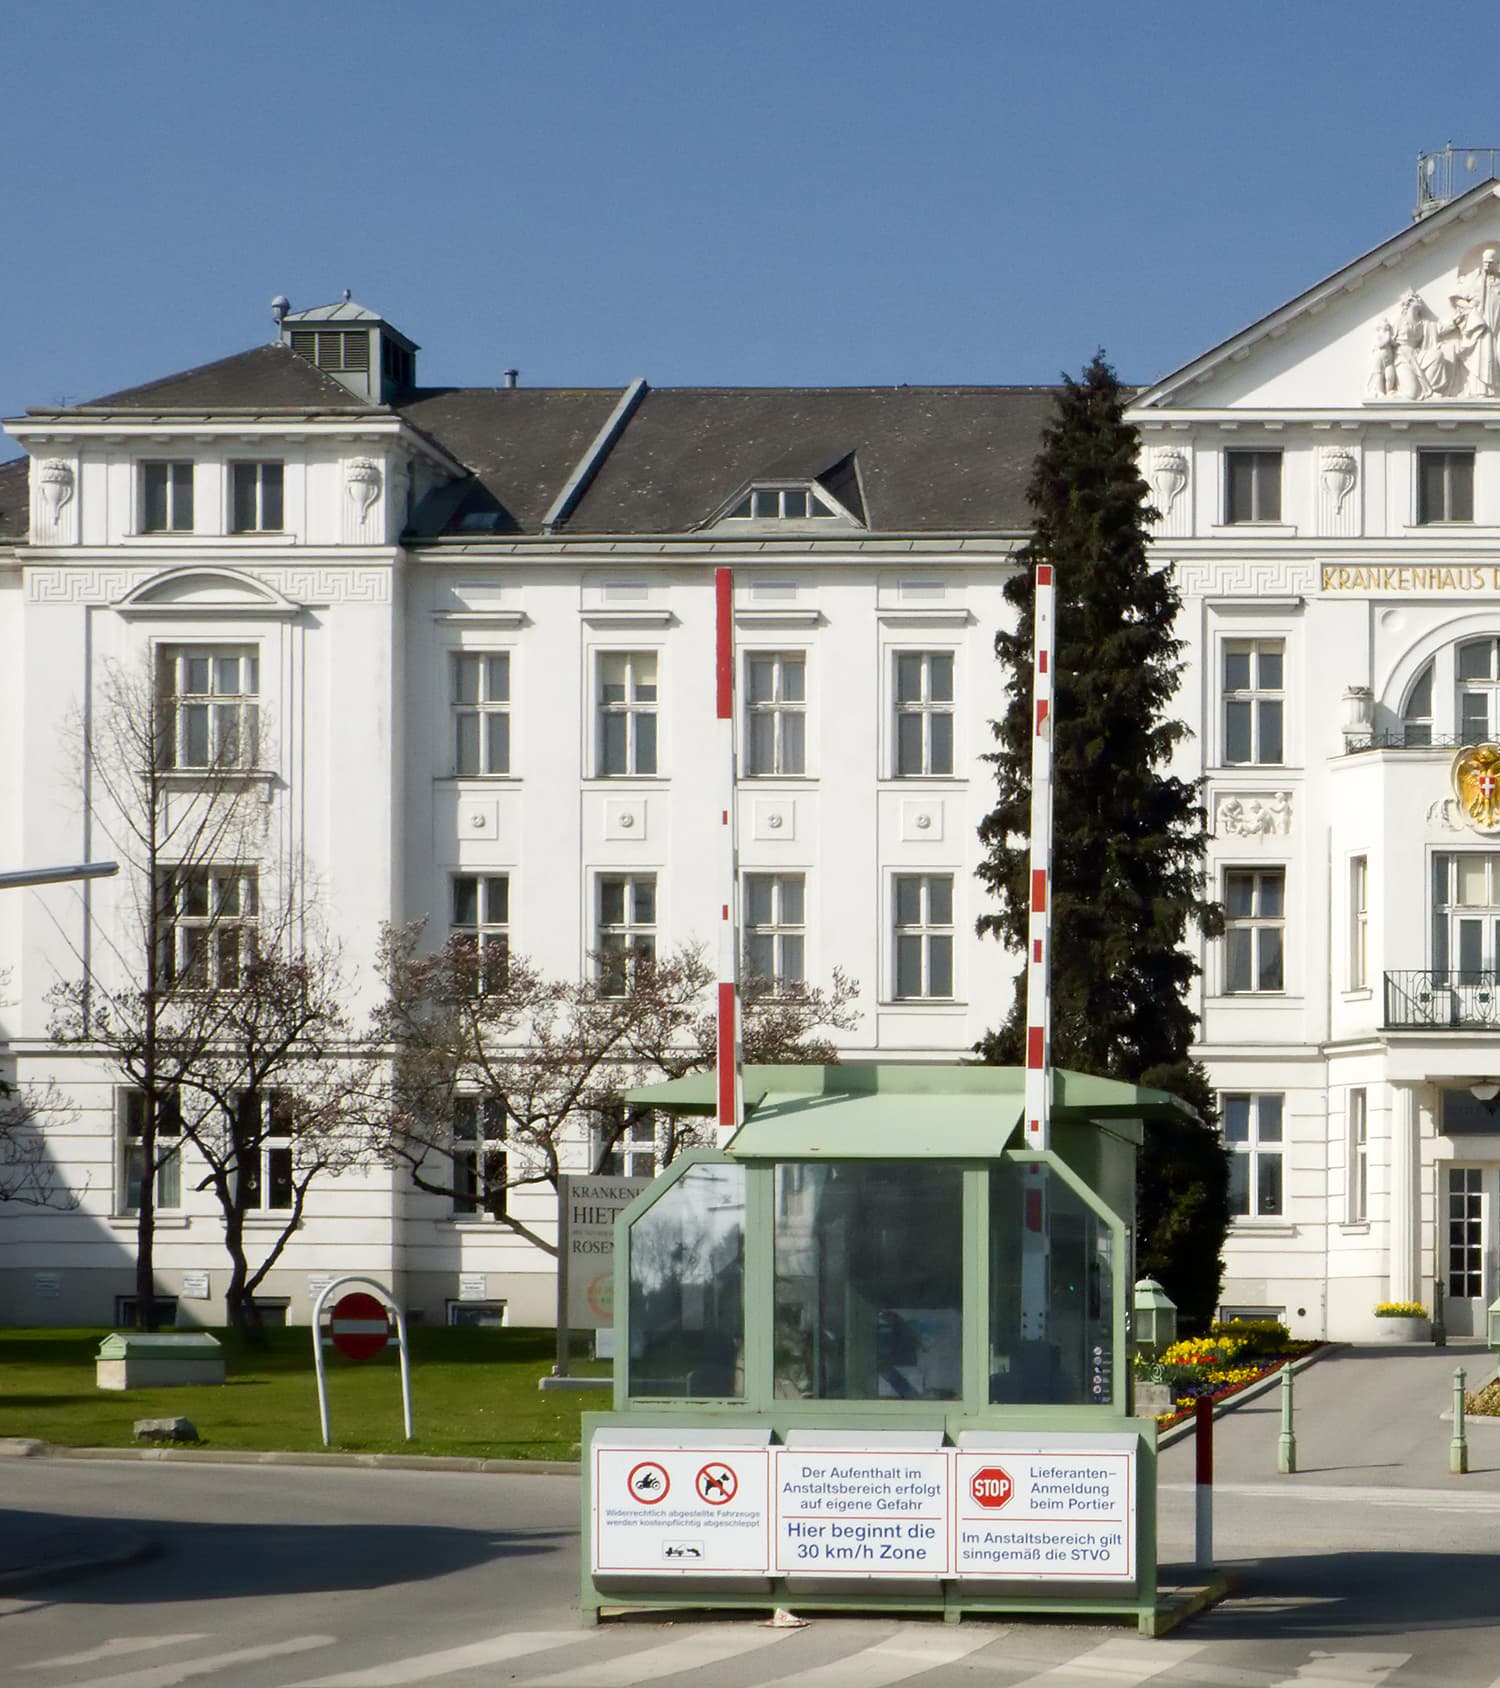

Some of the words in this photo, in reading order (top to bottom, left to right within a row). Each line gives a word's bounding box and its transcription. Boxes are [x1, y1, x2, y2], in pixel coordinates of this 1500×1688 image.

[1322, 566, 1485, 591] KRANKENHAUS
[572, 1186, 644, 1199] KRANKEN
[573, 1206, 624, 1225] HIET
[802, 1466, 826, 1478] Der
[830, 1467, 900, 1479] Aufenthalt
[905, 1468, 922, 1479] im
[783, 1482, 892, 1494] Anstaltsbereich
[895, 1483, 942, 1497] erfolgt
[974, 1479, 1010, 1497] STOP
[1030, 1483, 1110, 1496] Anmeldung
[800, 1498, 822, 1510] auf
[826, 1500, 872, 1512] eigene
[876, 1498, 923, 1510] Gefahr
[1030, 1498, 1064, 1510] beim
[1068, 1498, 1116, 1510] Portier
[606, 1509, 666, 1518] Widerrechtlich
[716, 1510, 760, 1519] Fahrzeuge
[640, 1519, 702, 1528] kostenpflichtig
[703, 1520, 760, 1528] abgeschleppt
[788, 1522, 826, 1538] Hier
[832, 1523, 902, 1542] beginnt
[908, 1524, 936, 1539] die
[962, 1532, 980, 1544] Im
[984, 1532, 1096, 1545] Anstaltsbereich
[1100, 1534, 1122, 1548] gilt
[798, 1544, 820, 1559] 30
[826, 1544, 874, 1560] km/h
[880, 1544, 927, 1560] Zone
[962, 1548, 1040, 1562] sinngemäß
[1045, 1548, 1066, 1560] die
[1070, 1549, 1110, 1561] STVO
